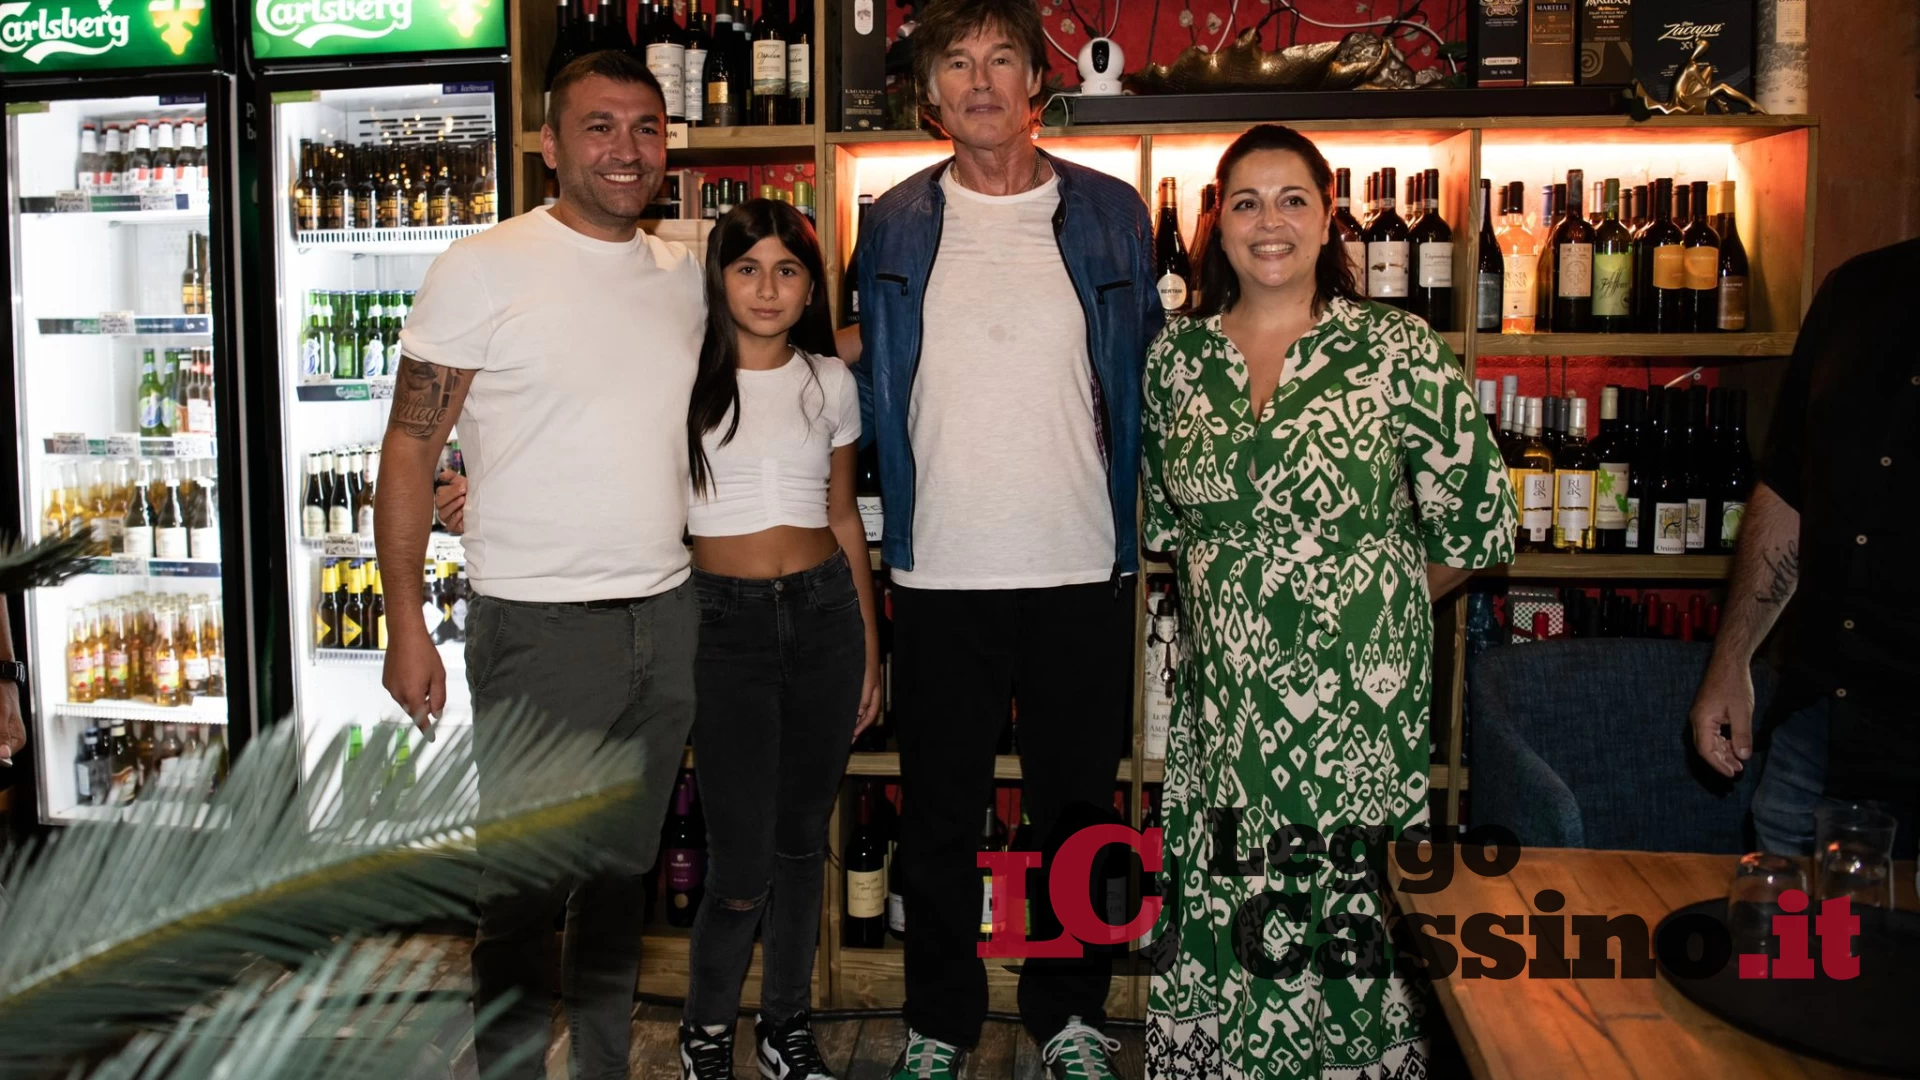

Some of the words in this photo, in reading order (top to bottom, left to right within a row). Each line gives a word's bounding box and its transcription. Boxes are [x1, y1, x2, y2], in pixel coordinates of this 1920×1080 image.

[0, 2, 129, 53] Carlsberg
[256, 0, 412, 37] Carlsberg
[1658, 23, 1721, 41] Zacapa
